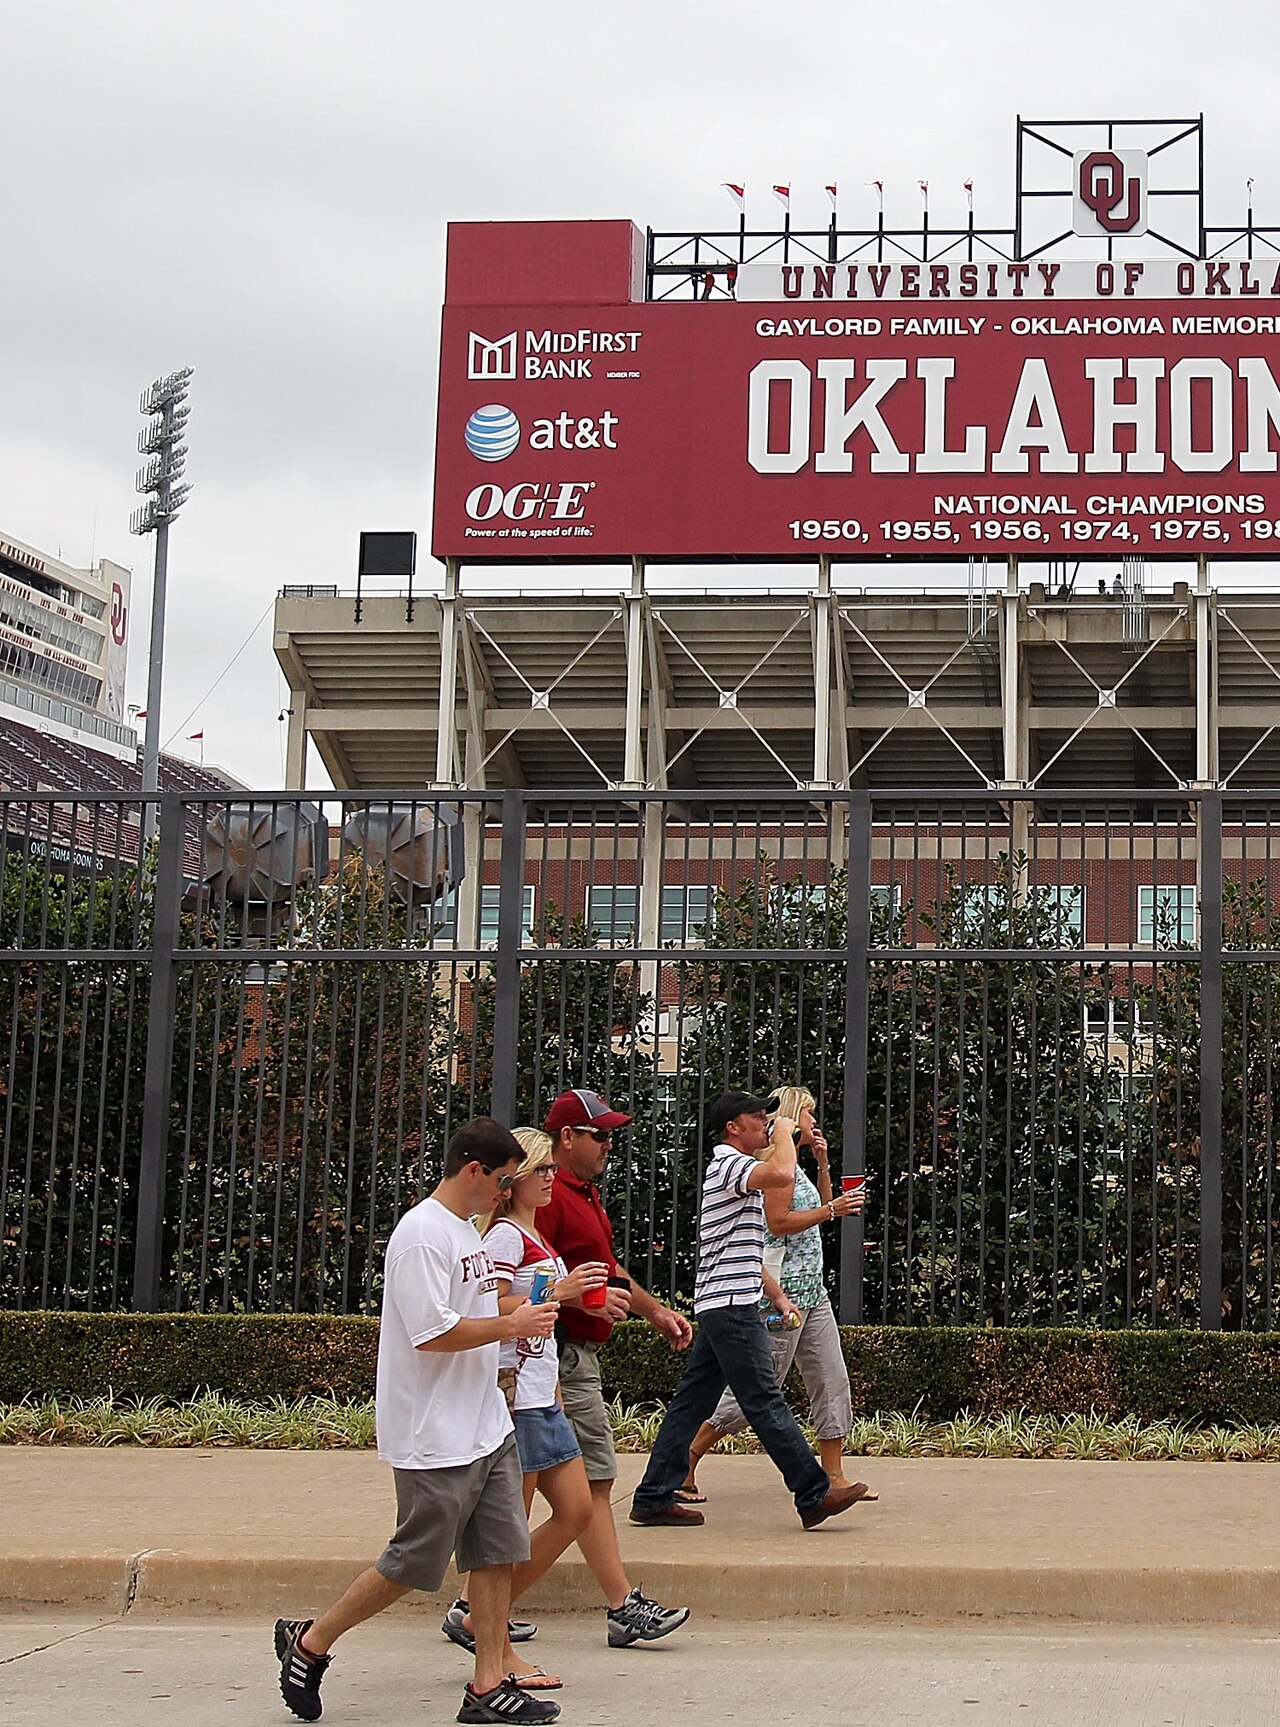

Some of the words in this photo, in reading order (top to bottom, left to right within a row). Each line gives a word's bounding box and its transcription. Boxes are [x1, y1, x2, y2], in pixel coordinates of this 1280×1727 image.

[1080, 151, 1141, 233] OU
[781, 264, 1061, 298] UNIVERSITY
[1096, 262, 1144, 295] OF
[755, 318, 882, 336] GAYLORD
[889, 317, 987, 336] FAMILY
[1010, 316, 1166, 335] OKLAHOMA
[529, 410, 619, 450] at&t
[934, 495, 1078, 514] NATIONAL
[1086, 494, 1266, 515] CHAMPIONS
[465, 527, 496, 537] Power
[498, 528, 510, 537] at
[511, 528, 528, 537] the
[529, 526, 560, 539] speed
[561, 527, 573, 537] of
[788, 520, 870, 543] 1950,
[879, 520, 961, 543] 1955,
[970, 520, 1050, 543] 1956,
[1060, 520, 1140, 544] 1974,
[1150, 519, 1231, 543] 1975,
